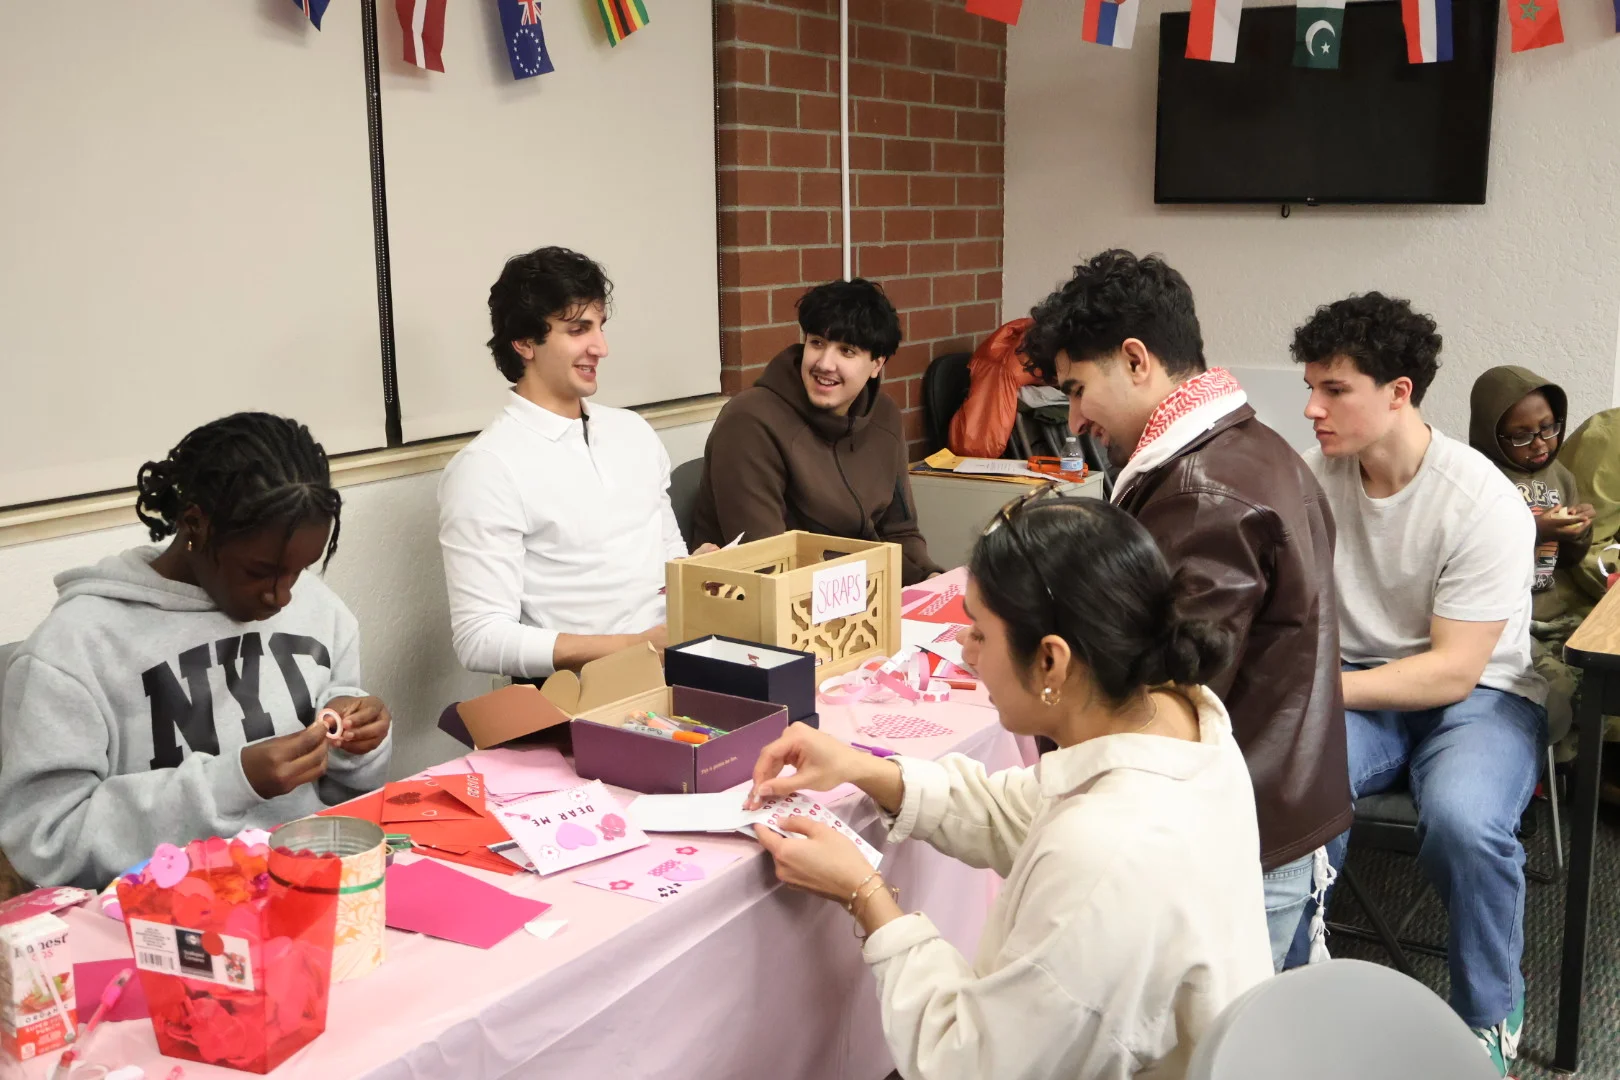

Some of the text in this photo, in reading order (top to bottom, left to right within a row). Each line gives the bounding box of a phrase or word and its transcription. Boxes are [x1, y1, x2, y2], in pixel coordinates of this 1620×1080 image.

[816, 574, 861, 614] SCRAPS
[142, 632, 331, 770] NYC
[531, 805, 595, 827] DEAR ME
[25, 1003, 69, 1023] ORGANC
